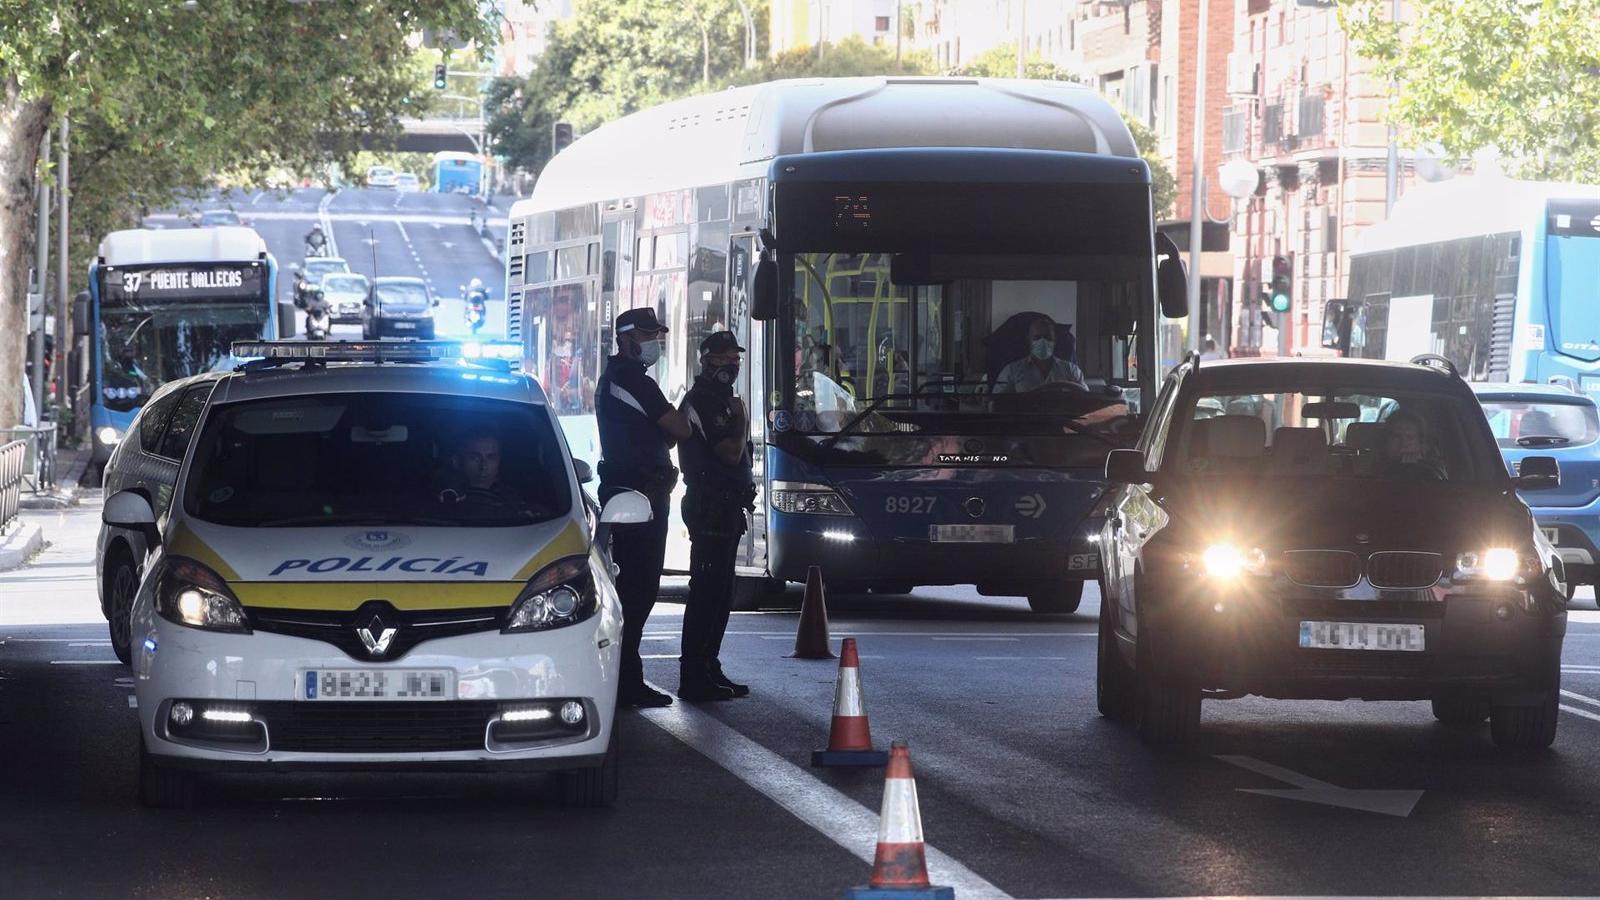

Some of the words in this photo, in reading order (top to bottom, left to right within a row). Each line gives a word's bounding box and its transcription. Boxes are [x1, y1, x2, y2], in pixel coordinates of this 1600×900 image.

[123, 273, 142, 293] 37
[151, 272, 189, 289] PUENTE
[191, 271, 242, 288] VALLECAS
[885, 496, 937, 514] 8927
[268, 556, 489, 577] POLICÍA
